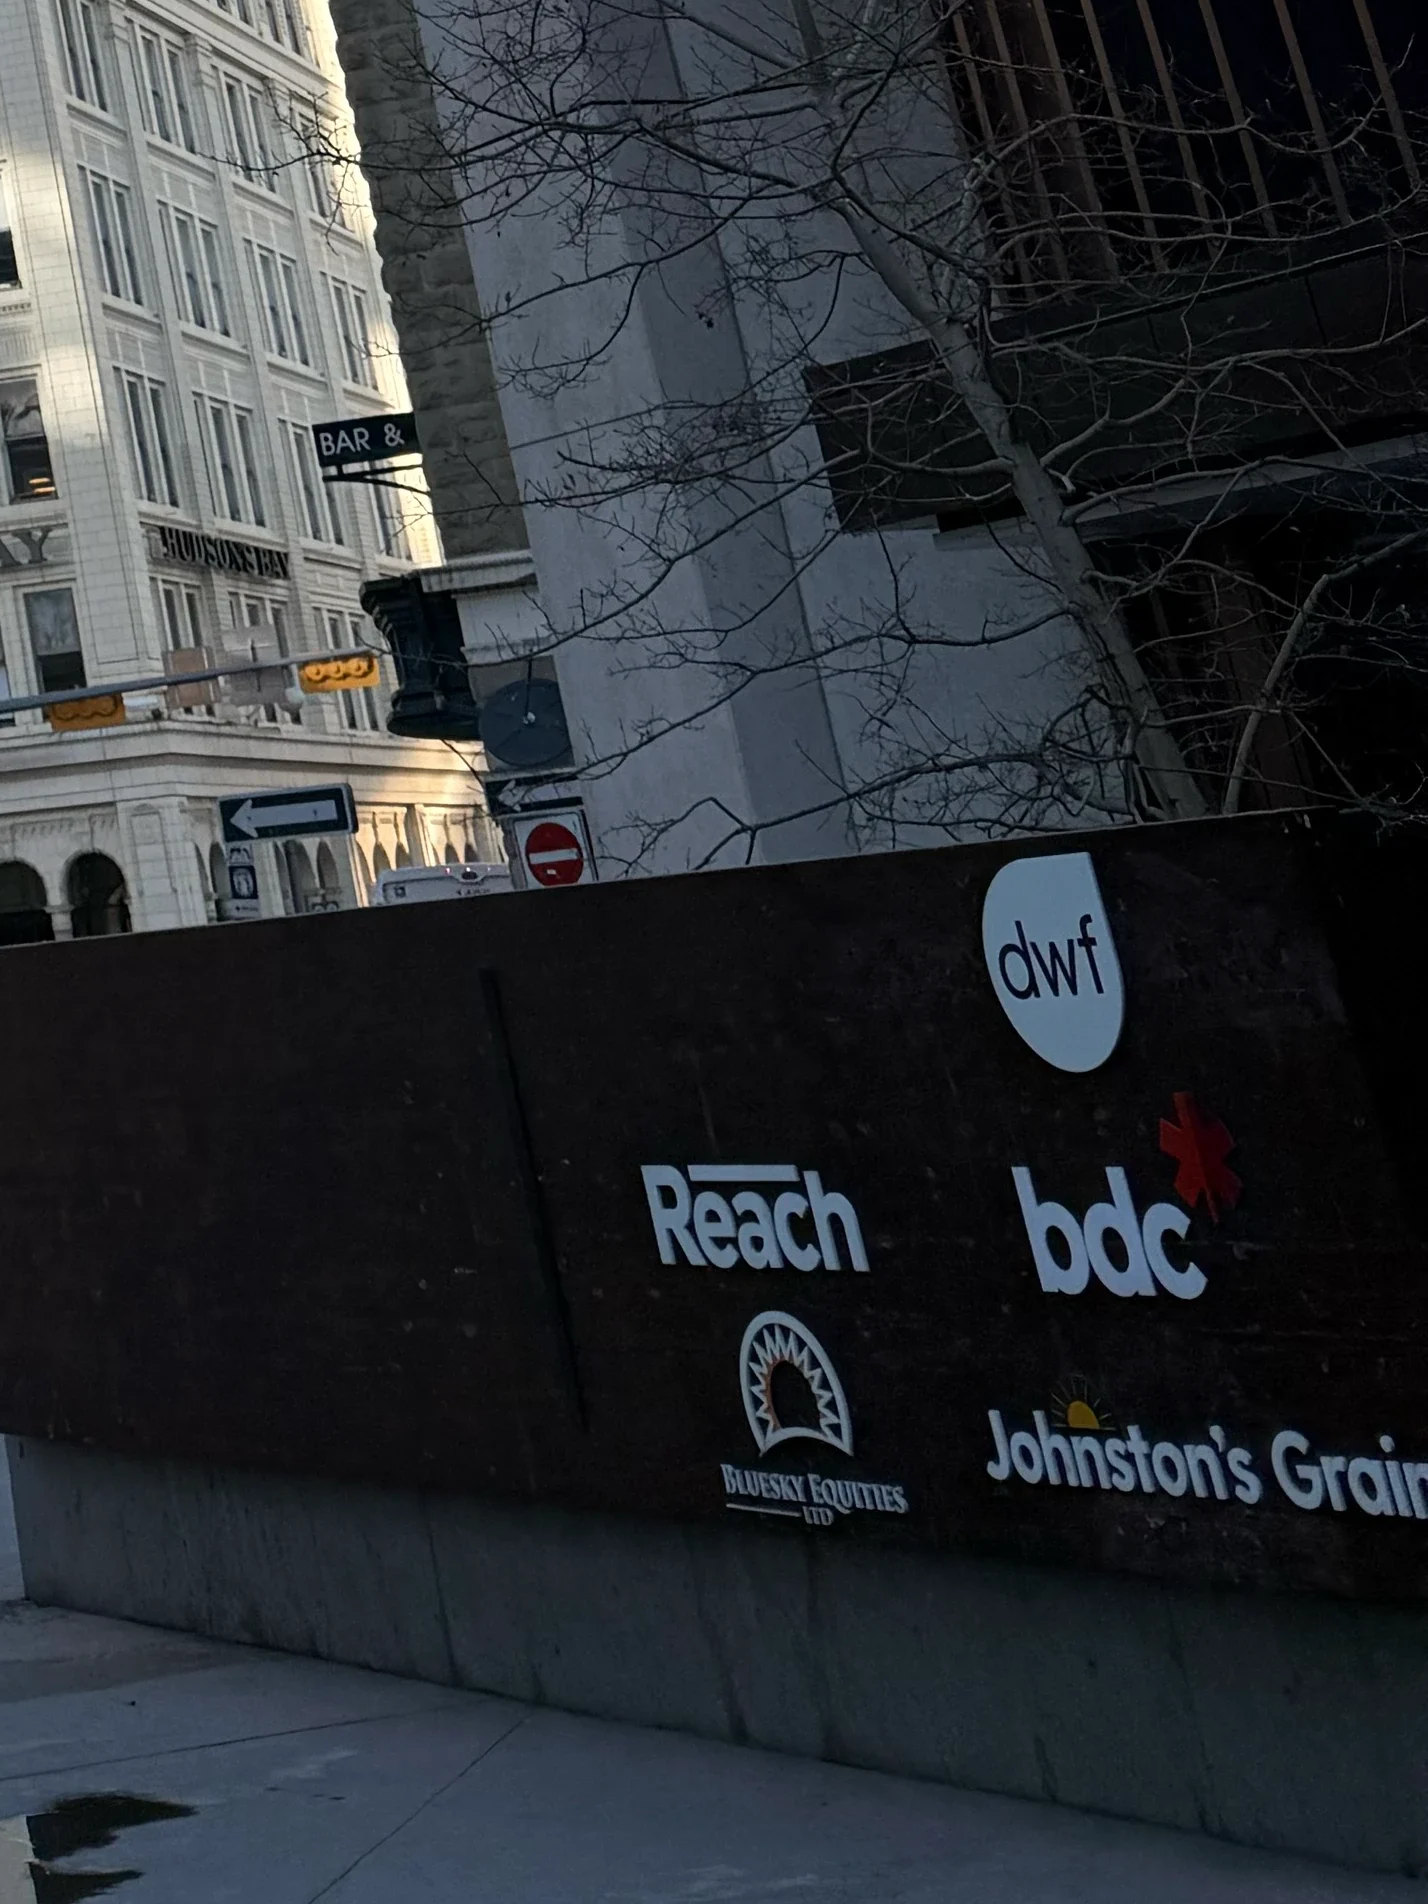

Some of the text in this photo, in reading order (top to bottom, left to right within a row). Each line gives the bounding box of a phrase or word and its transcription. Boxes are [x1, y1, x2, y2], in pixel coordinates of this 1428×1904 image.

[319, 422, 406, 457] BAR &
[997, 915, 1103, 1001] dwf
[640, 1164, 871, 1274] Reach
[1011, 1166, 1209, 1301] bdc
[720, 1463, 909, 1515] BLUESKY EQUITIES
[985, 1409, 1263, 1506] Johnston's
